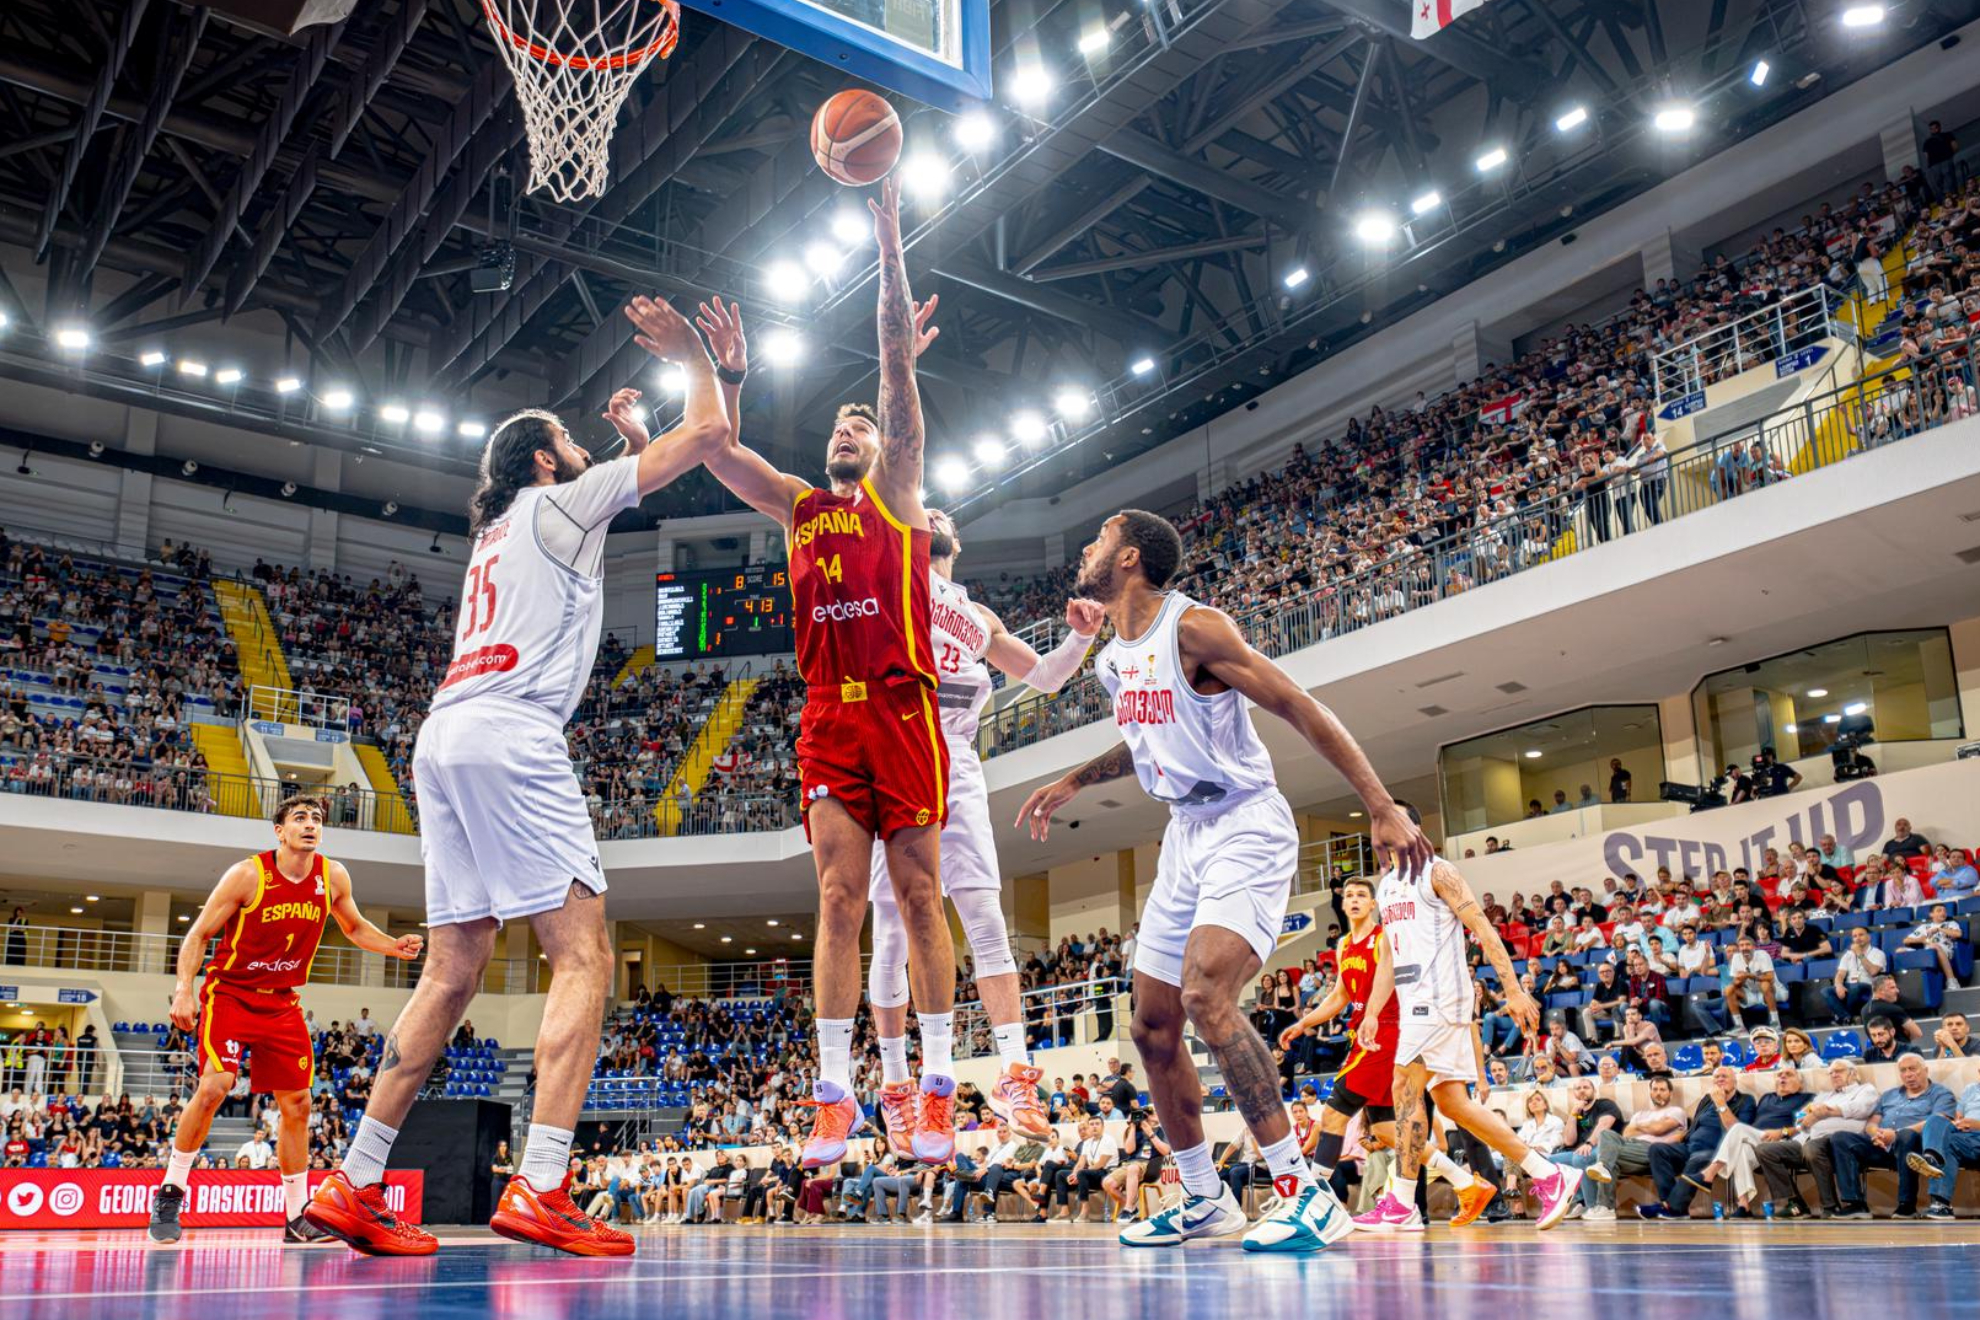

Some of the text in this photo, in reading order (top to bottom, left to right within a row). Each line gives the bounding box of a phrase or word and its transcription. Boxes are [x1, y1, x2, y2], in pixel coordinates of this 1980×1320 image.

[1671, 405, 1684, 419] 14
[735, 574, 745, 591] 8
[773, 572, 786, 586] 15
[815, 553, 843, 585] 14
[462, 554, 500, 642] 35
[745, 597, 774, 614] 4 13
[939, 642, 961, 674] 23
[1740, 825, 1776, 872] IT
[261, 900, 322, 924] ESPAÑA
[285, 932, 295, 953] 1
[98, 1184, 192, 1214] GEORGA
[196, 1184, 285, 1214] BASKETBA
